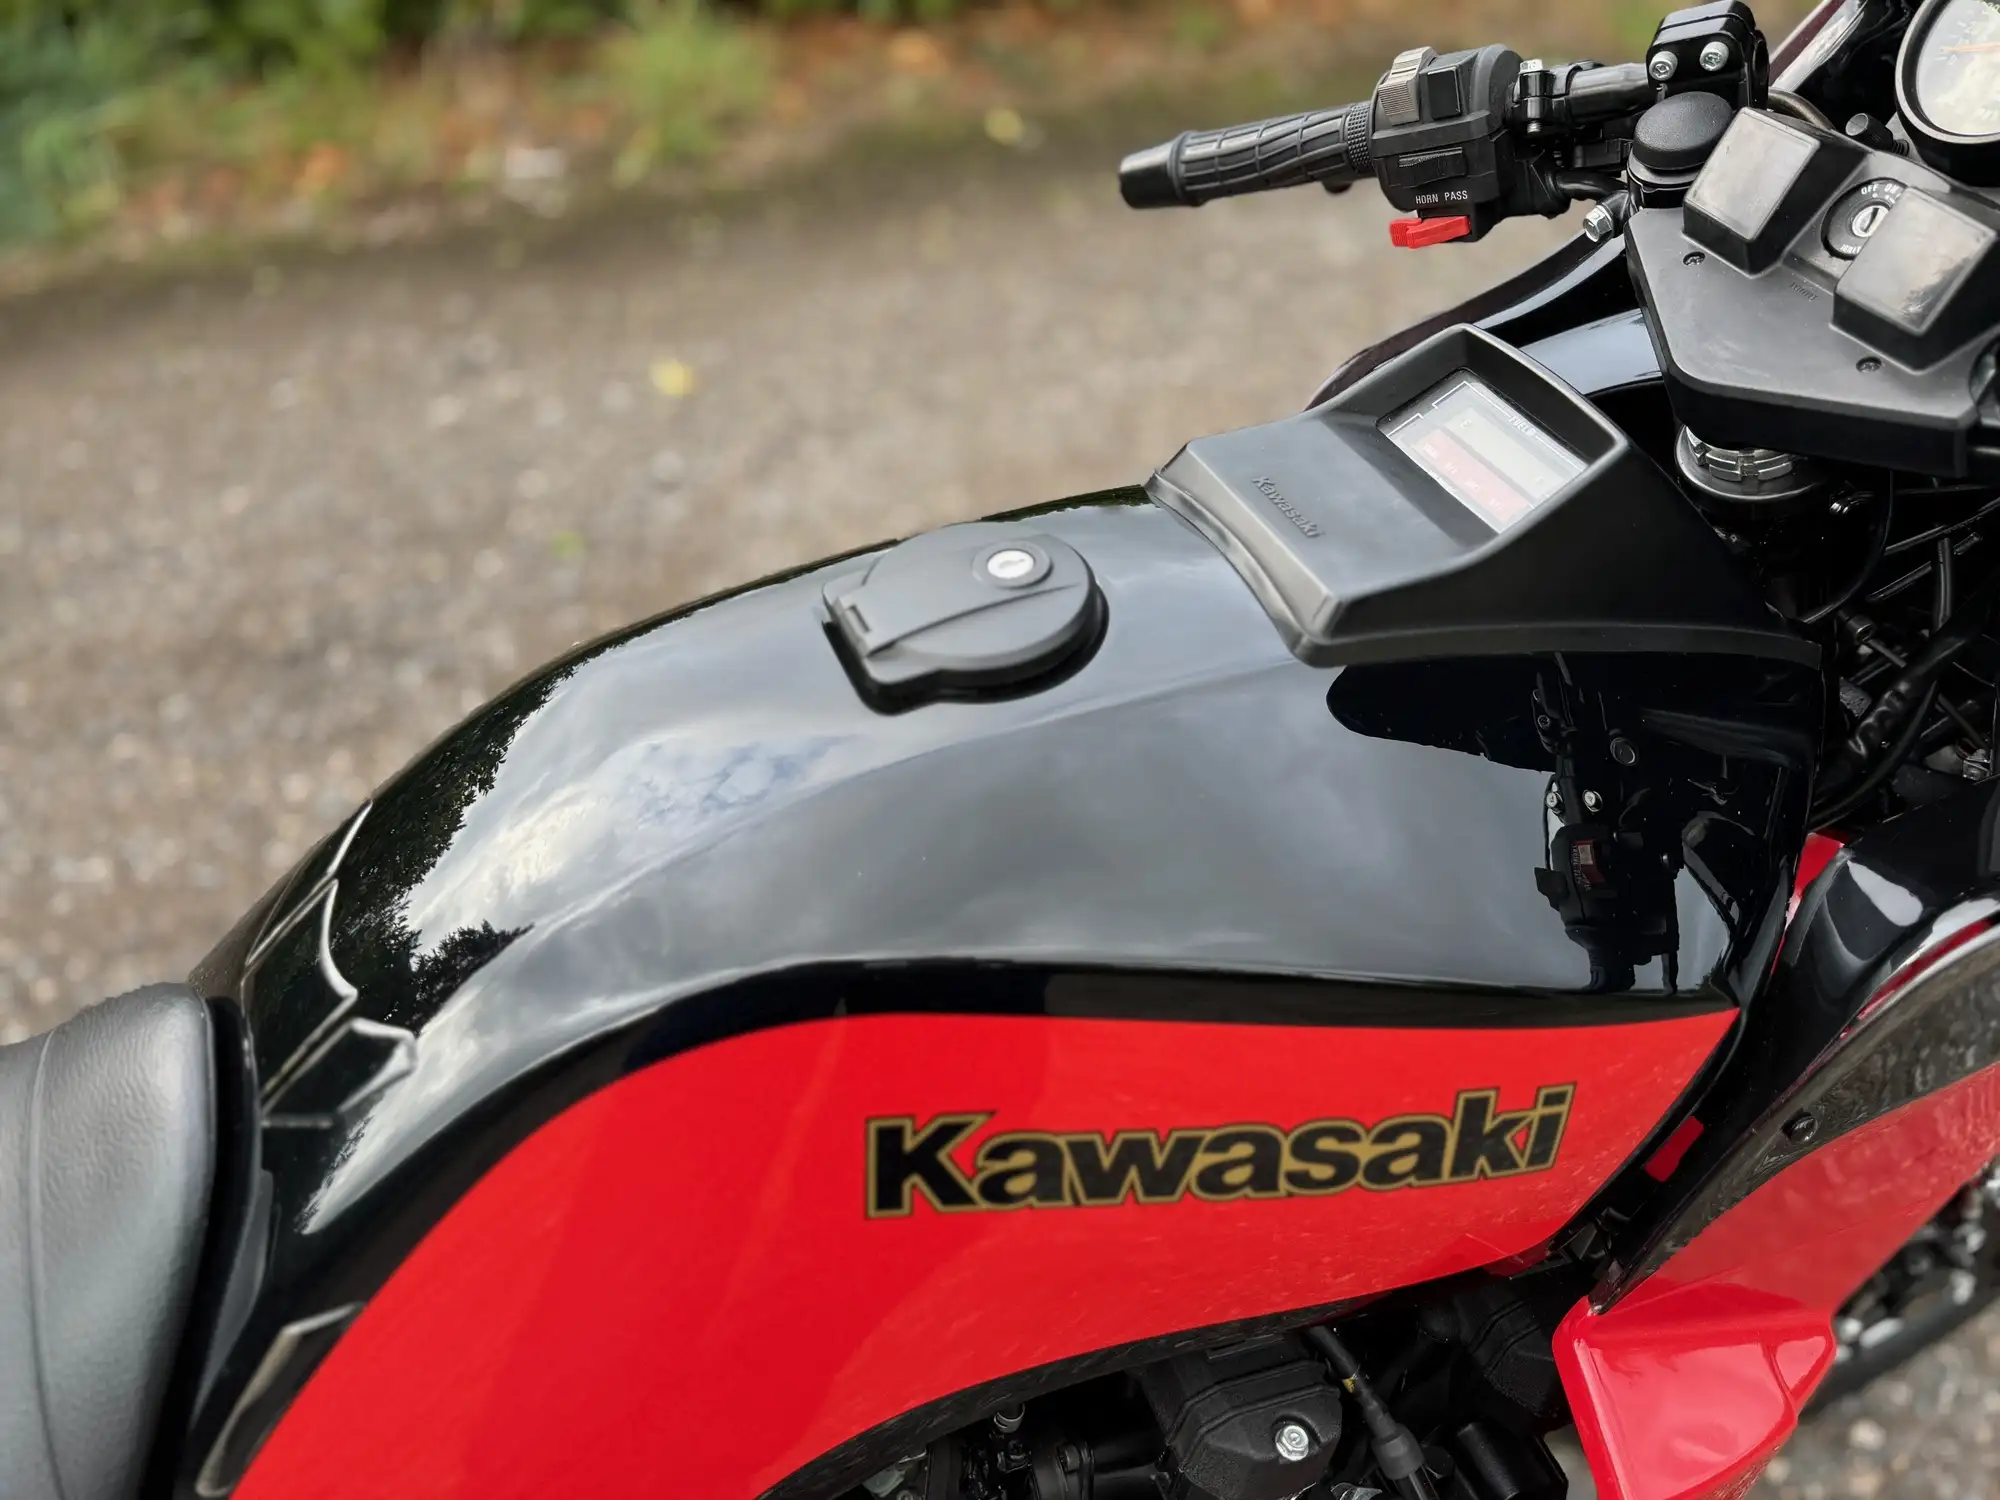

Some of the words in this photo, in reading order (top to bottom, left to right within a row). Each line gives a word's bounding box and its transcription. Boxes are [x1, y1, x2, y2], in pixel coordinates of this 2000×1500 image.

[1415, 194, 1439, 204] HORN
[1444, 190, 1468, 200] PASS
[1861, 184, 1879, 195] OFF
[1884, 183, 1899, 194] ON
[1252, 476, 1322, 539] Kawasaki
[866, 1083, 1577, 1220] Kawasaki
